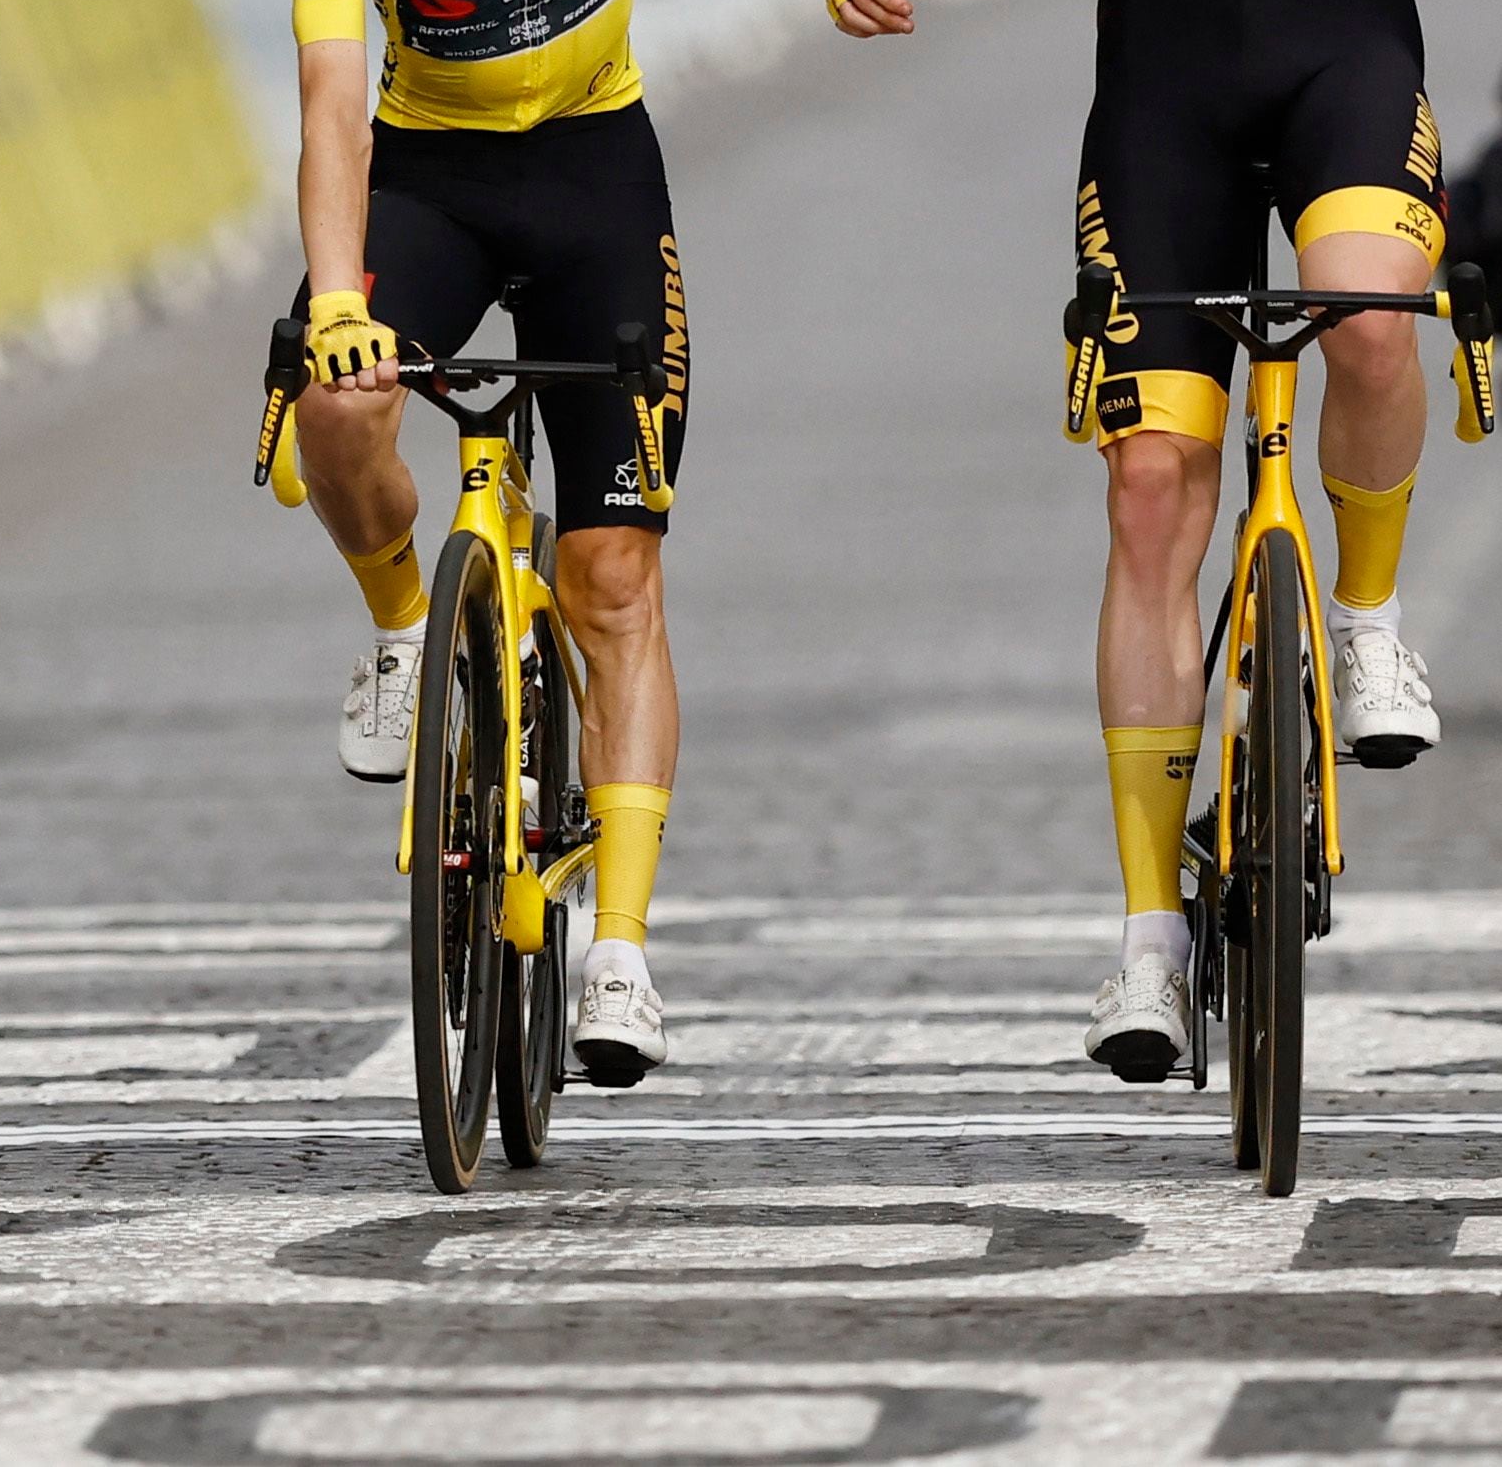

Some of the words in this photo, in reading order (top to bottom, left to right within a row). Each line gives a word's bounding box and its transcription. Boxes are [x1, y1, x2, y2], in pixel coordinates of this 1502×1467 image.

[508, 13, 548, 37] lease
[1394, 221, 1432, 252] AGU
[661, 233, 691, 422] JUMBO
[1194, 296, 1248, 308] cervélo
[1070, 336, 1095, 417] SRAM
[1099, 396, 1138, 417] HEMA
[1469, 339, 1494, 418] SRAM
[256, 388, 285, 465] SRAM
[633, 394, 659, 472] SRAM
